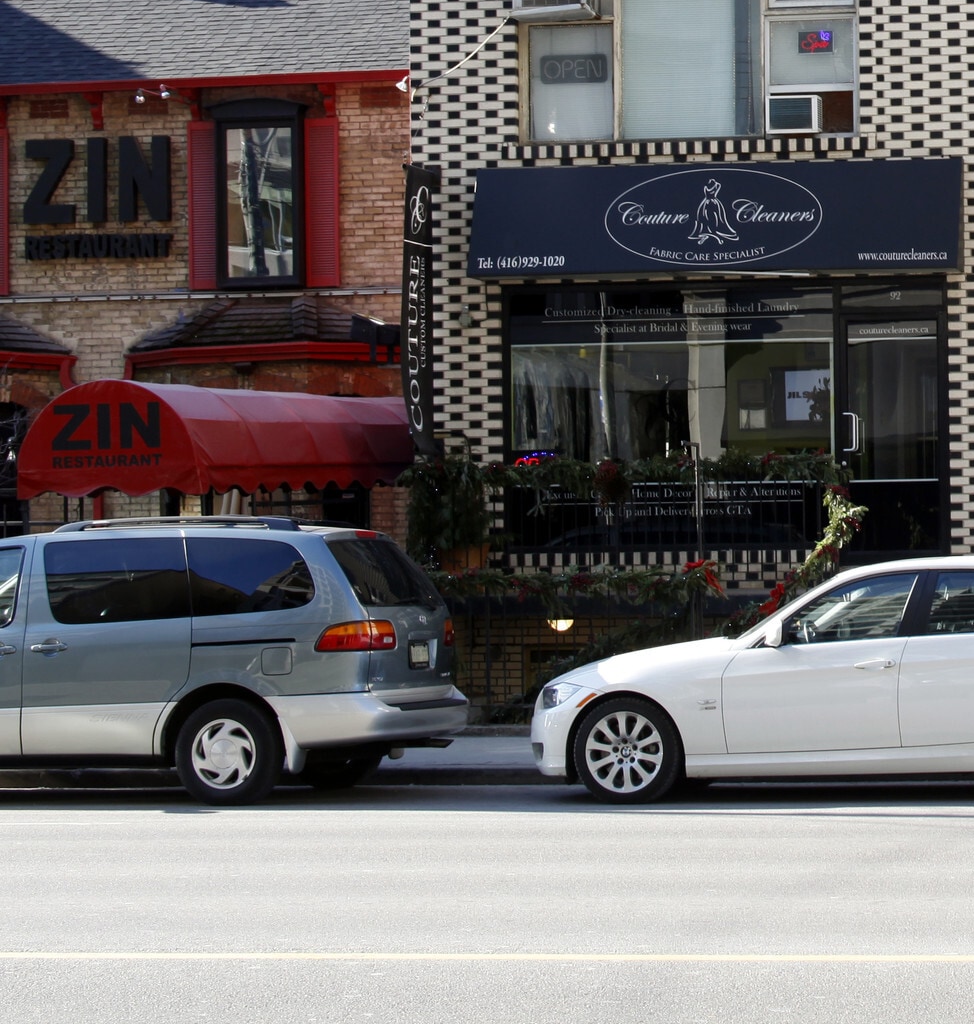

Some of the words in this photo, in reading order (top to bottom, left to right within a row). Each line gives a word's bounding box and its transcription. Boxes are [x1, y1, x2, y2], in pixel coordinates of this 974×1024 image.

[801, 33, 829, 54] Spa
[543, 58, 602, 79] OPEN
[24, 135, 172, 224] ZIN
[618, 201, 690, 226] Couture
[731, 198, 815, 224] Cleaners
[25, 233, 173, 261] RESTAURANT
[649, 246, 683, 260] FABRIC
[685, 251, 710, 261] CARE
[713, 246, 766, 261] SPECIALIST
[858, 248, 948, 261] www.couturecleaners.ca
[477, 257, 494, 269] Tel:
[497, 255, 565, 269] (416)929-1020
[890, 291, 901, 301] 92
[544, 306, 604, 318] Customized
[607, 304, 671, 316] Dry-cleaning
[684, 302, 753, 314] Hand-finished
[757, 301, 800, 314] Laundry
[594, 323, 637, 335] Specialist
[638, 325, 647, 333] at
[650, 322, 677, 333] Bridal
[680, 322, 688, 332] &
[691, 321, 728, 334] Evening
[730, 323, 753, 331] wear
[859, 325, 929, 335] couturecleaners.ca
[408, 255, 424, 432] COUTURE
[52, 402, 161, 451] ZIN
[52, 453, 162, 469] RESTAURANT
[706, 487, 737, 500] Repar
[739, 487, 748, 497] &
[751, 486, 802, 497] Atertions
[726, 505, 752, 516] GTA
